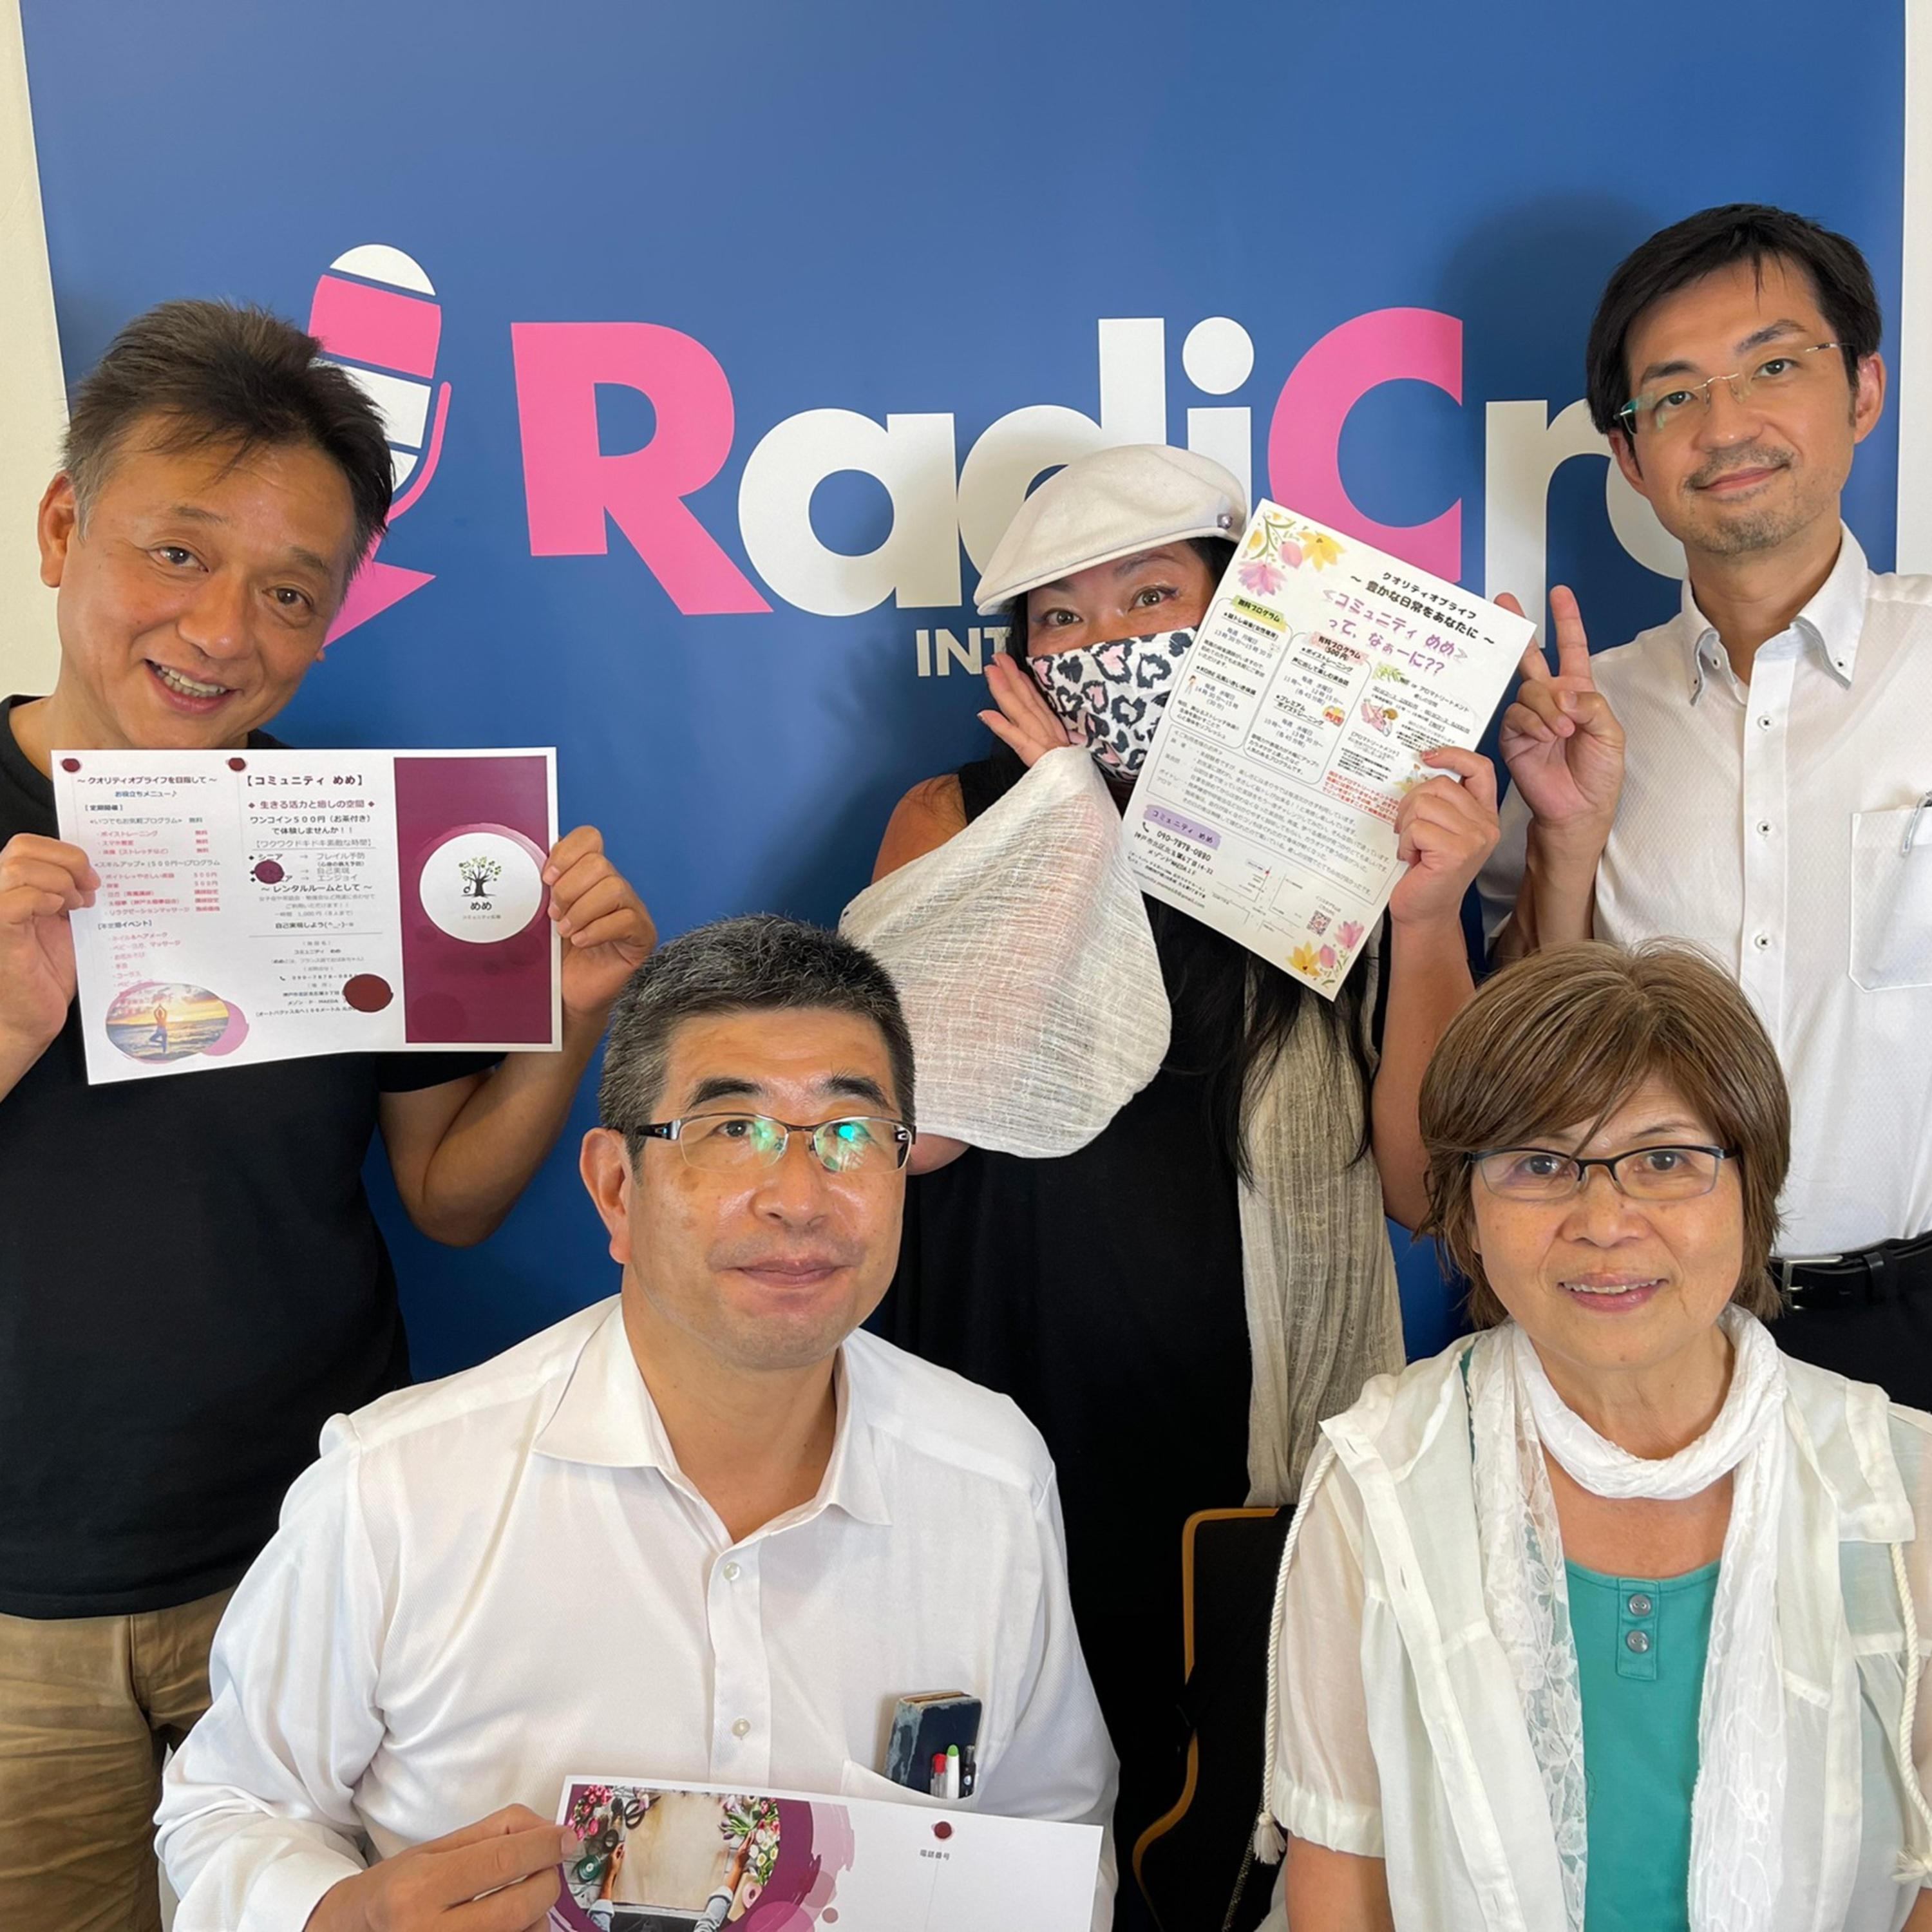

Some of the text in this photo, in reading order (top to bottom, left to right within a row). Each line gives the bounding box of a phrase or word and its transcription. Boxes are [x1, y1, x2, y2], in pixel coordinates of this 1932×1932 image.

[1365, 579, 1480, 639] 豊かな日常をあなたに
[1381, 570, 1477, 621] クオリティオブライフ
